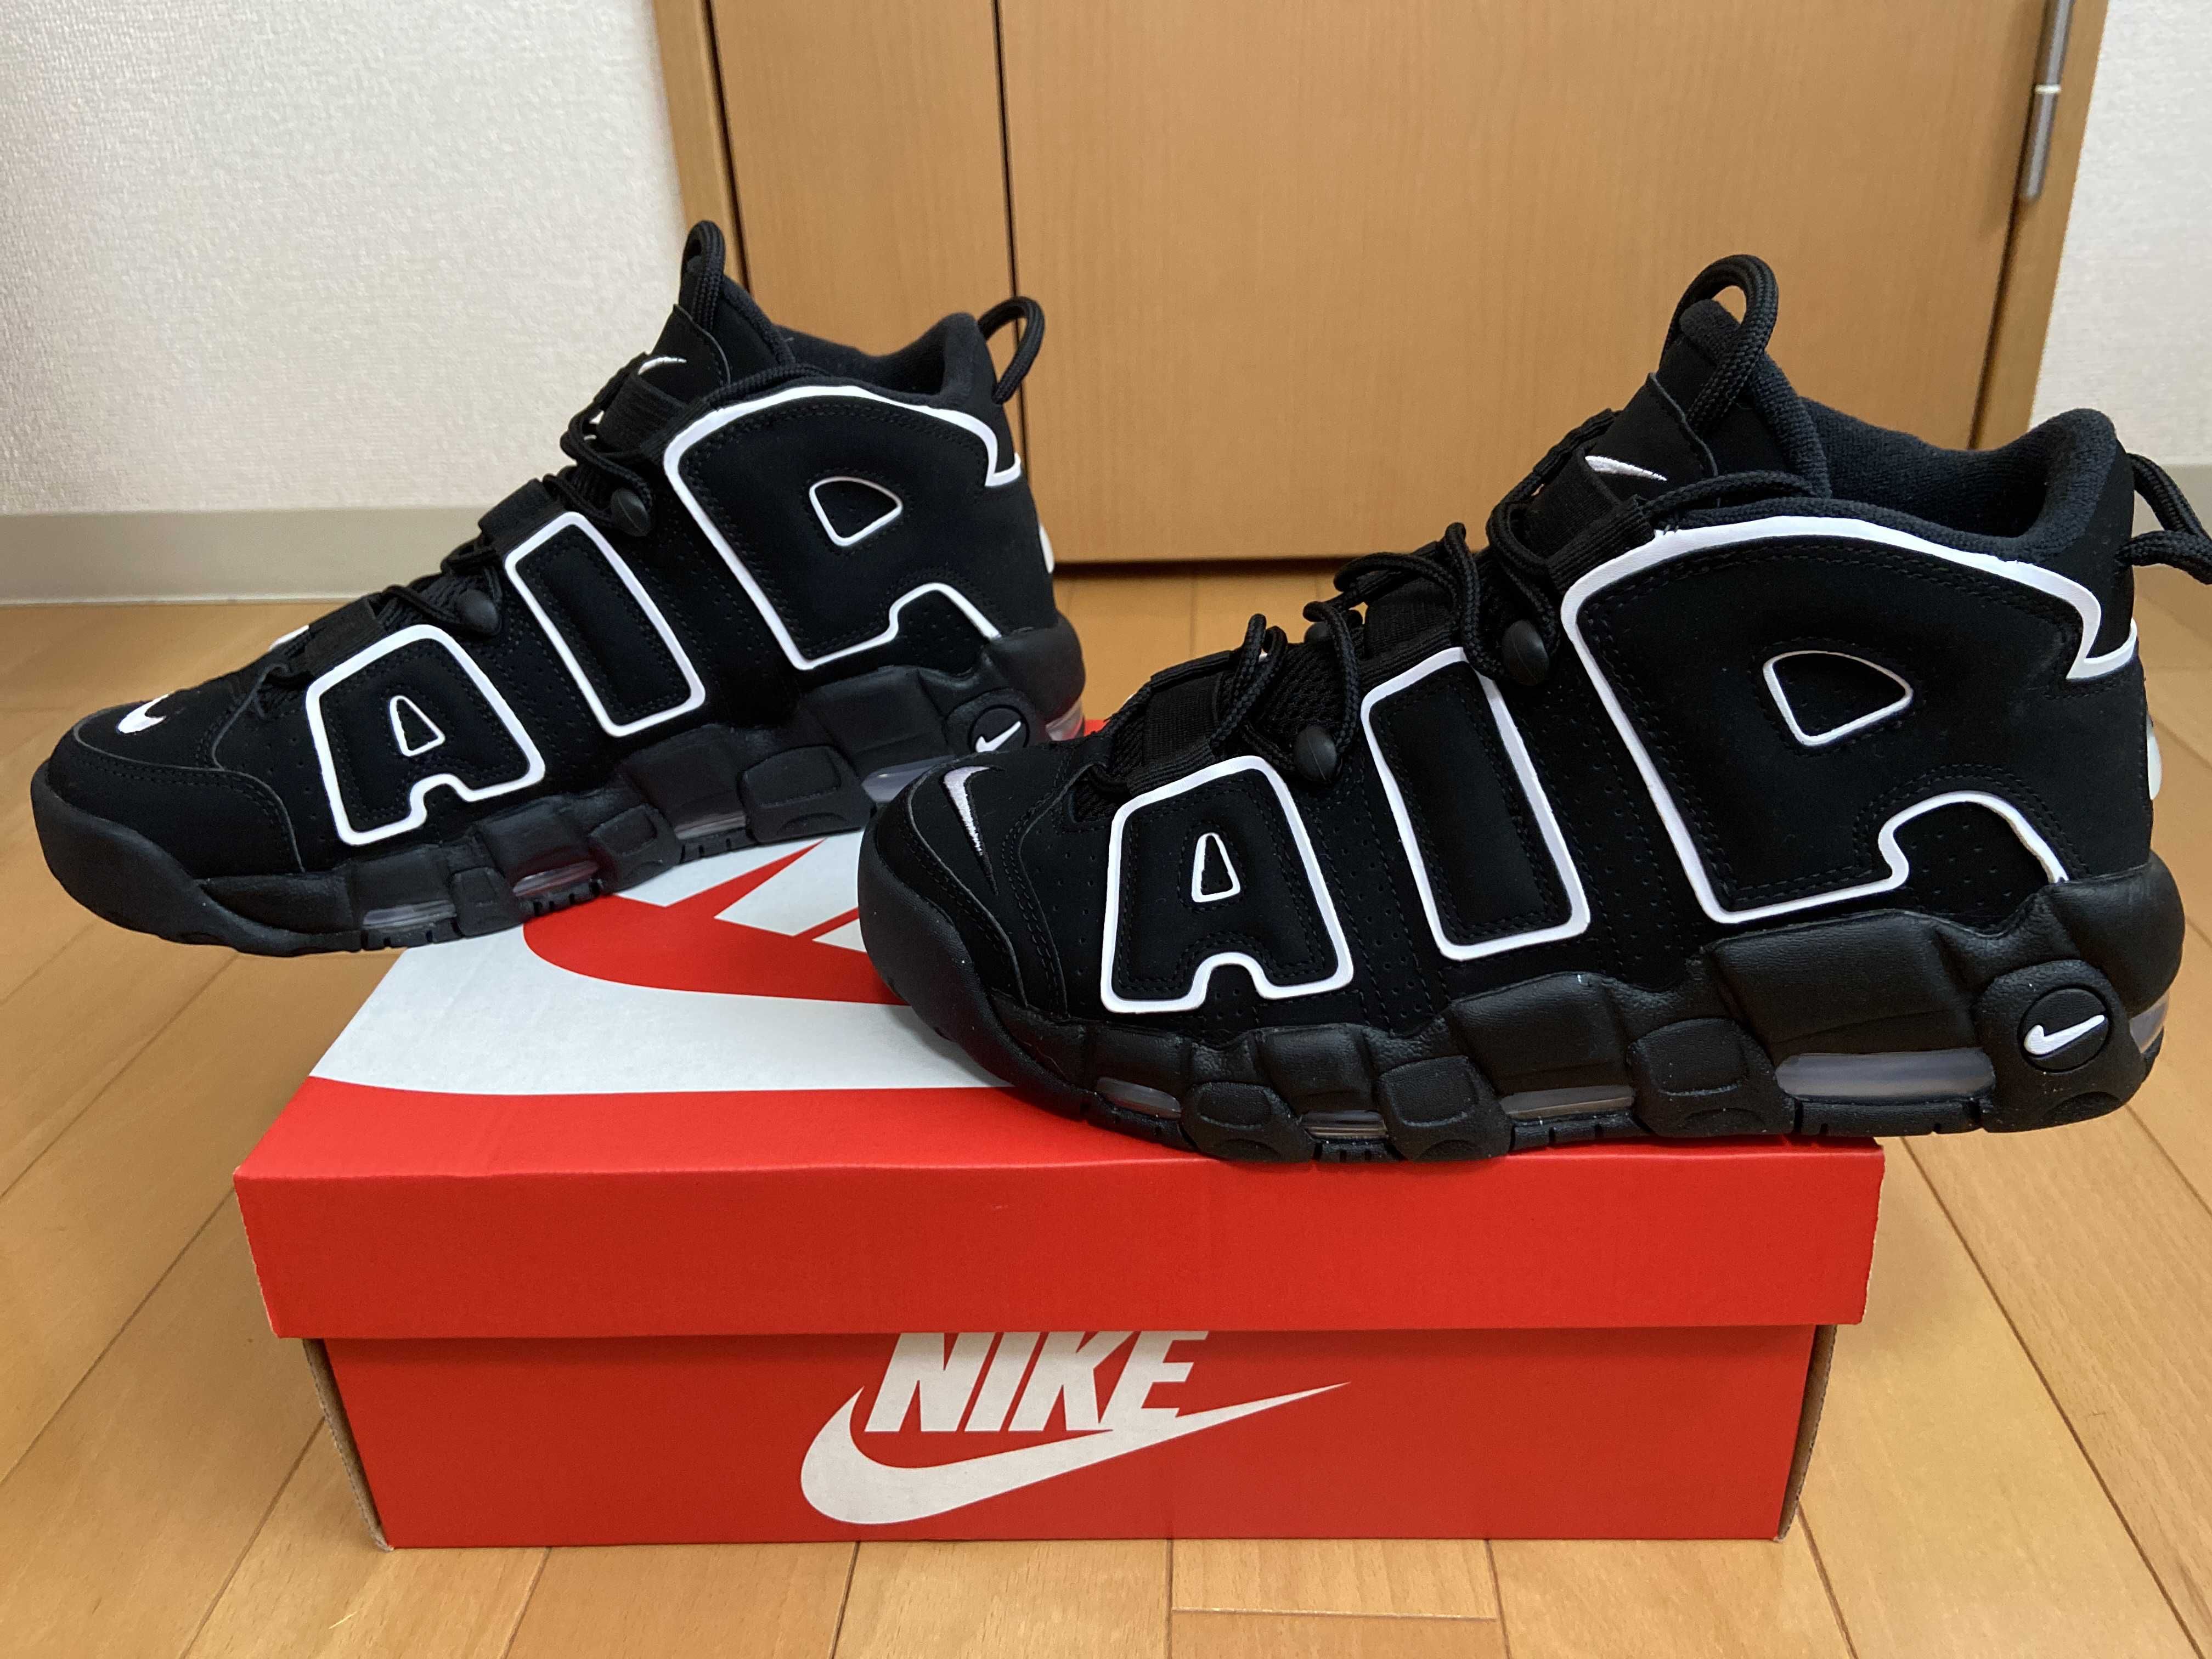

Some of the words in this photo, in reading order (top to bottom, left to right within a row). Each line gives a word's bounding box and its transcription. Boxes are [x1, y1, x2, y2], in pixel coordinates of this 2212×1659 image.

[305, 384, 1022, 846] AIR
[1101, 515, 2138, 1015] AIR
[864, 1330, 1209, 1432] NIKE
